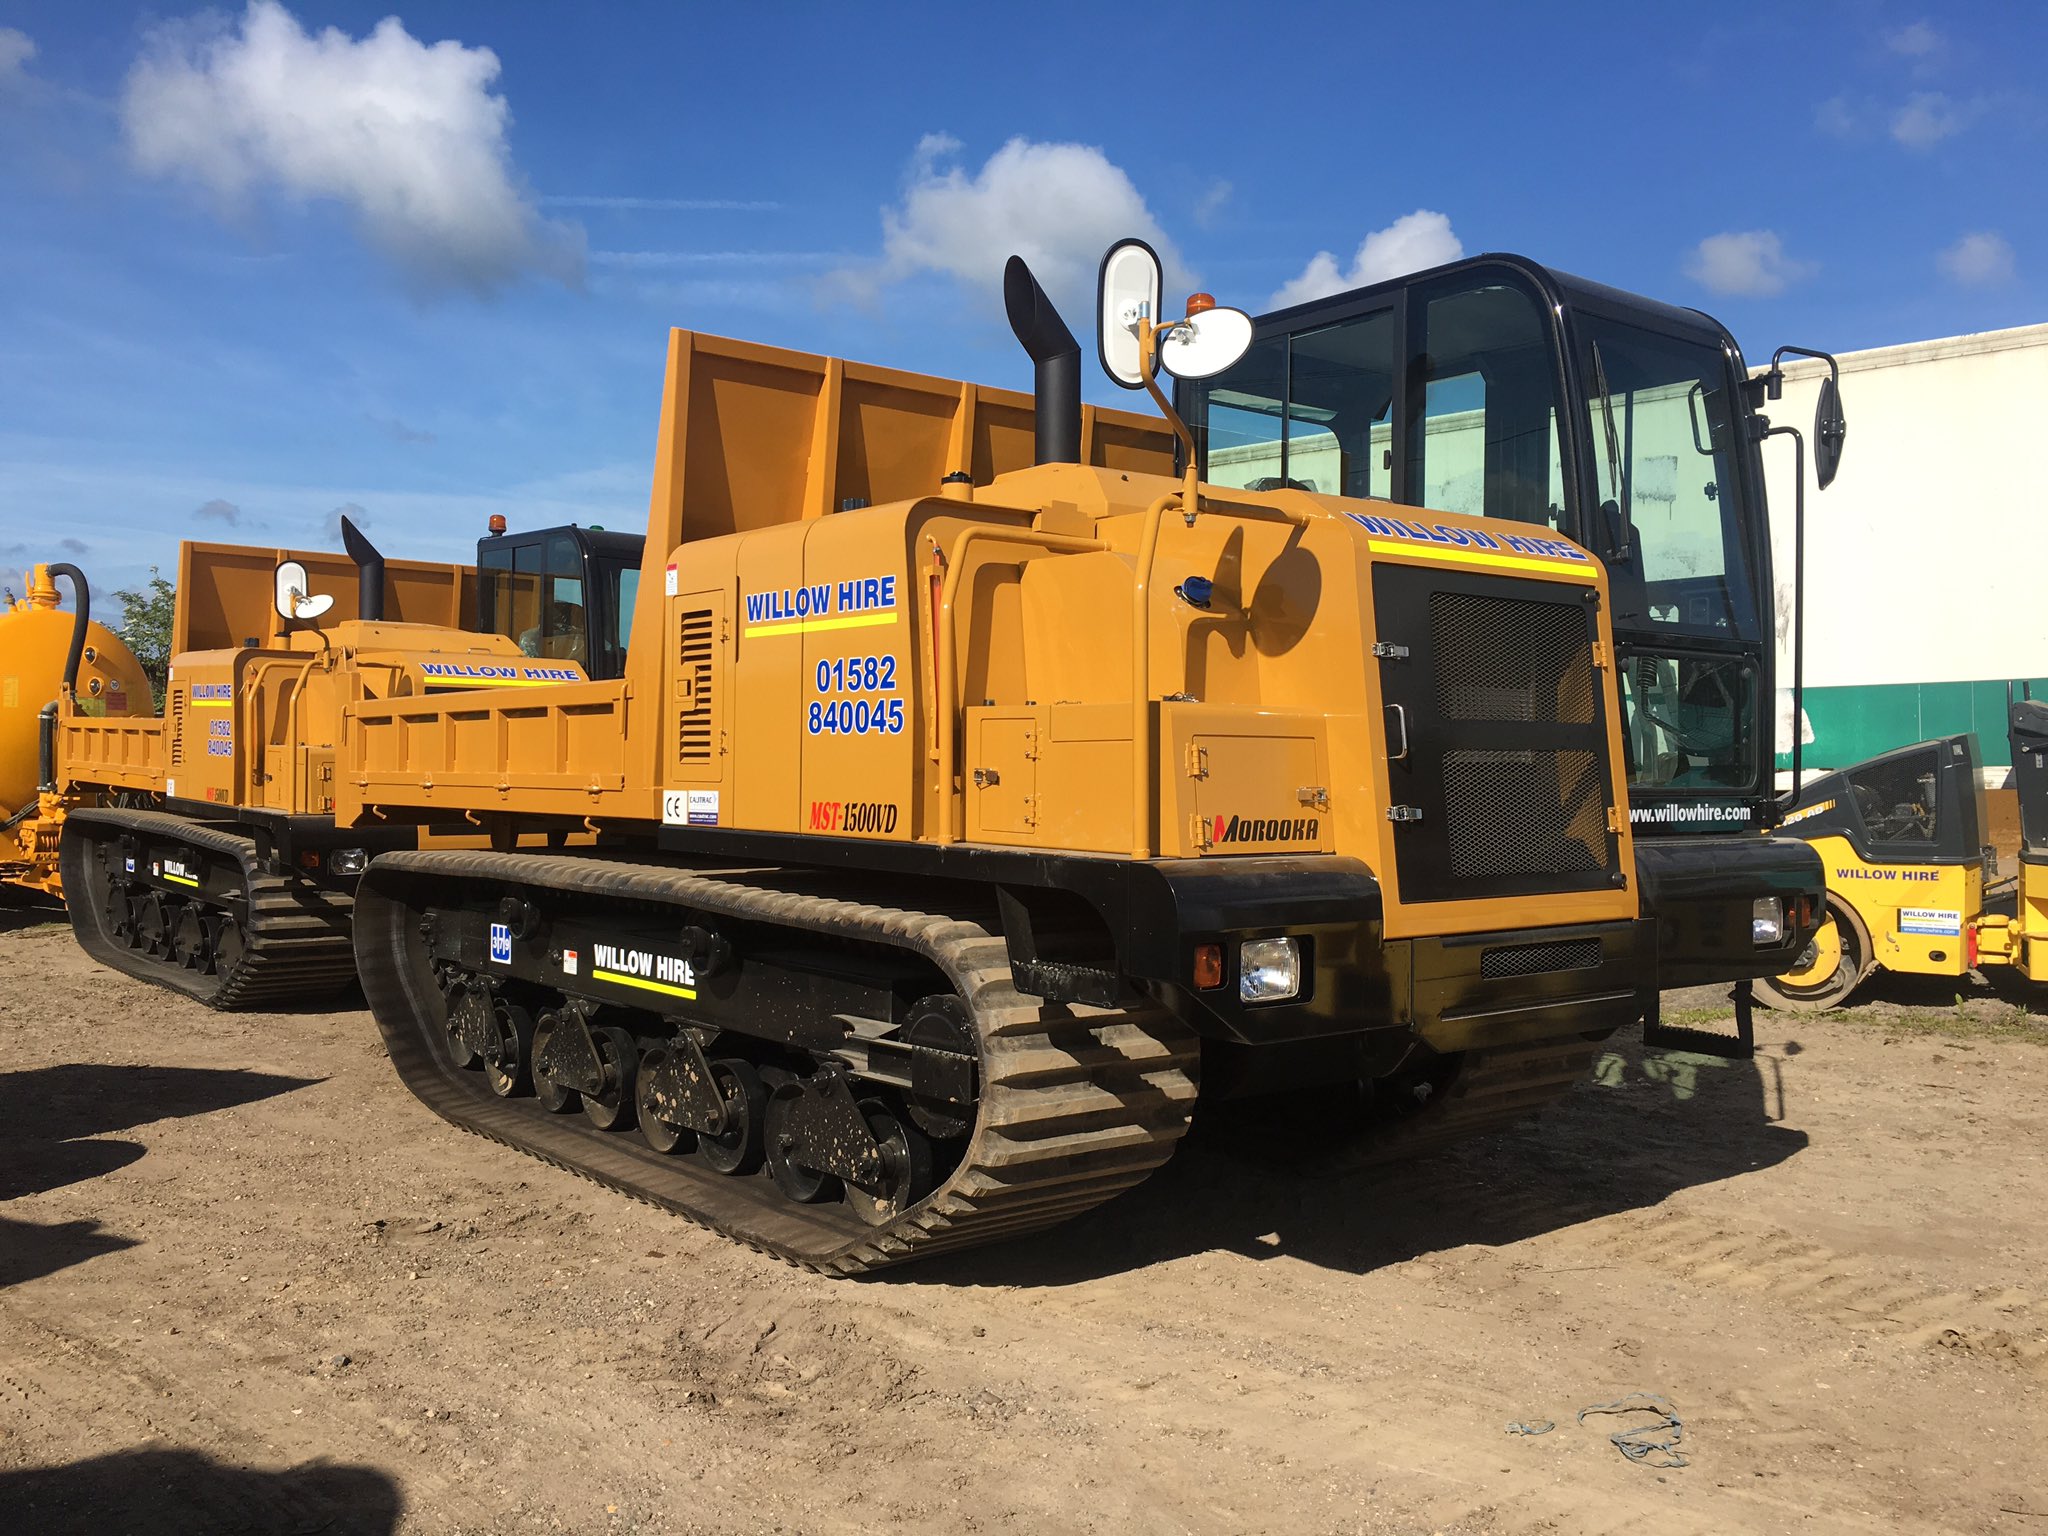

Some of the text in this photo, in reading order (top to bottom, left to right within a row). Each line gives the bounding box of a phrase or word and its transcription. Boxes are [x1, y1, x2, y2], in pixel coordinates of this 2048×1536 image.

[1343, 511, 1588, 561] WILLOW HIRE
[746, 575, 896, 622] WILLOW HIRE
[419, 662, 580, 681] WILLOW HIRE
[816, 654, 896, 693] 01582
[191, 684, 231, 699] WILLOW HIRE
[808, 698, 904, 735] 840045
[210, 719, 231, 736] 01582
[208, 739, 232, 757] 840045
[666, 797, 680, 817] CE
[1629, 804, 1751, 822] ww.willowhire.com
[809, 802, 898, 833] MST-1500VD
[1836, 868, 1940, 881] WILLOW HIRE
[1902, 910, 1936, 918] WILLOW
[593, 943, 653, 977] WILLOW
[656, 955, 695, 986] HIRE
